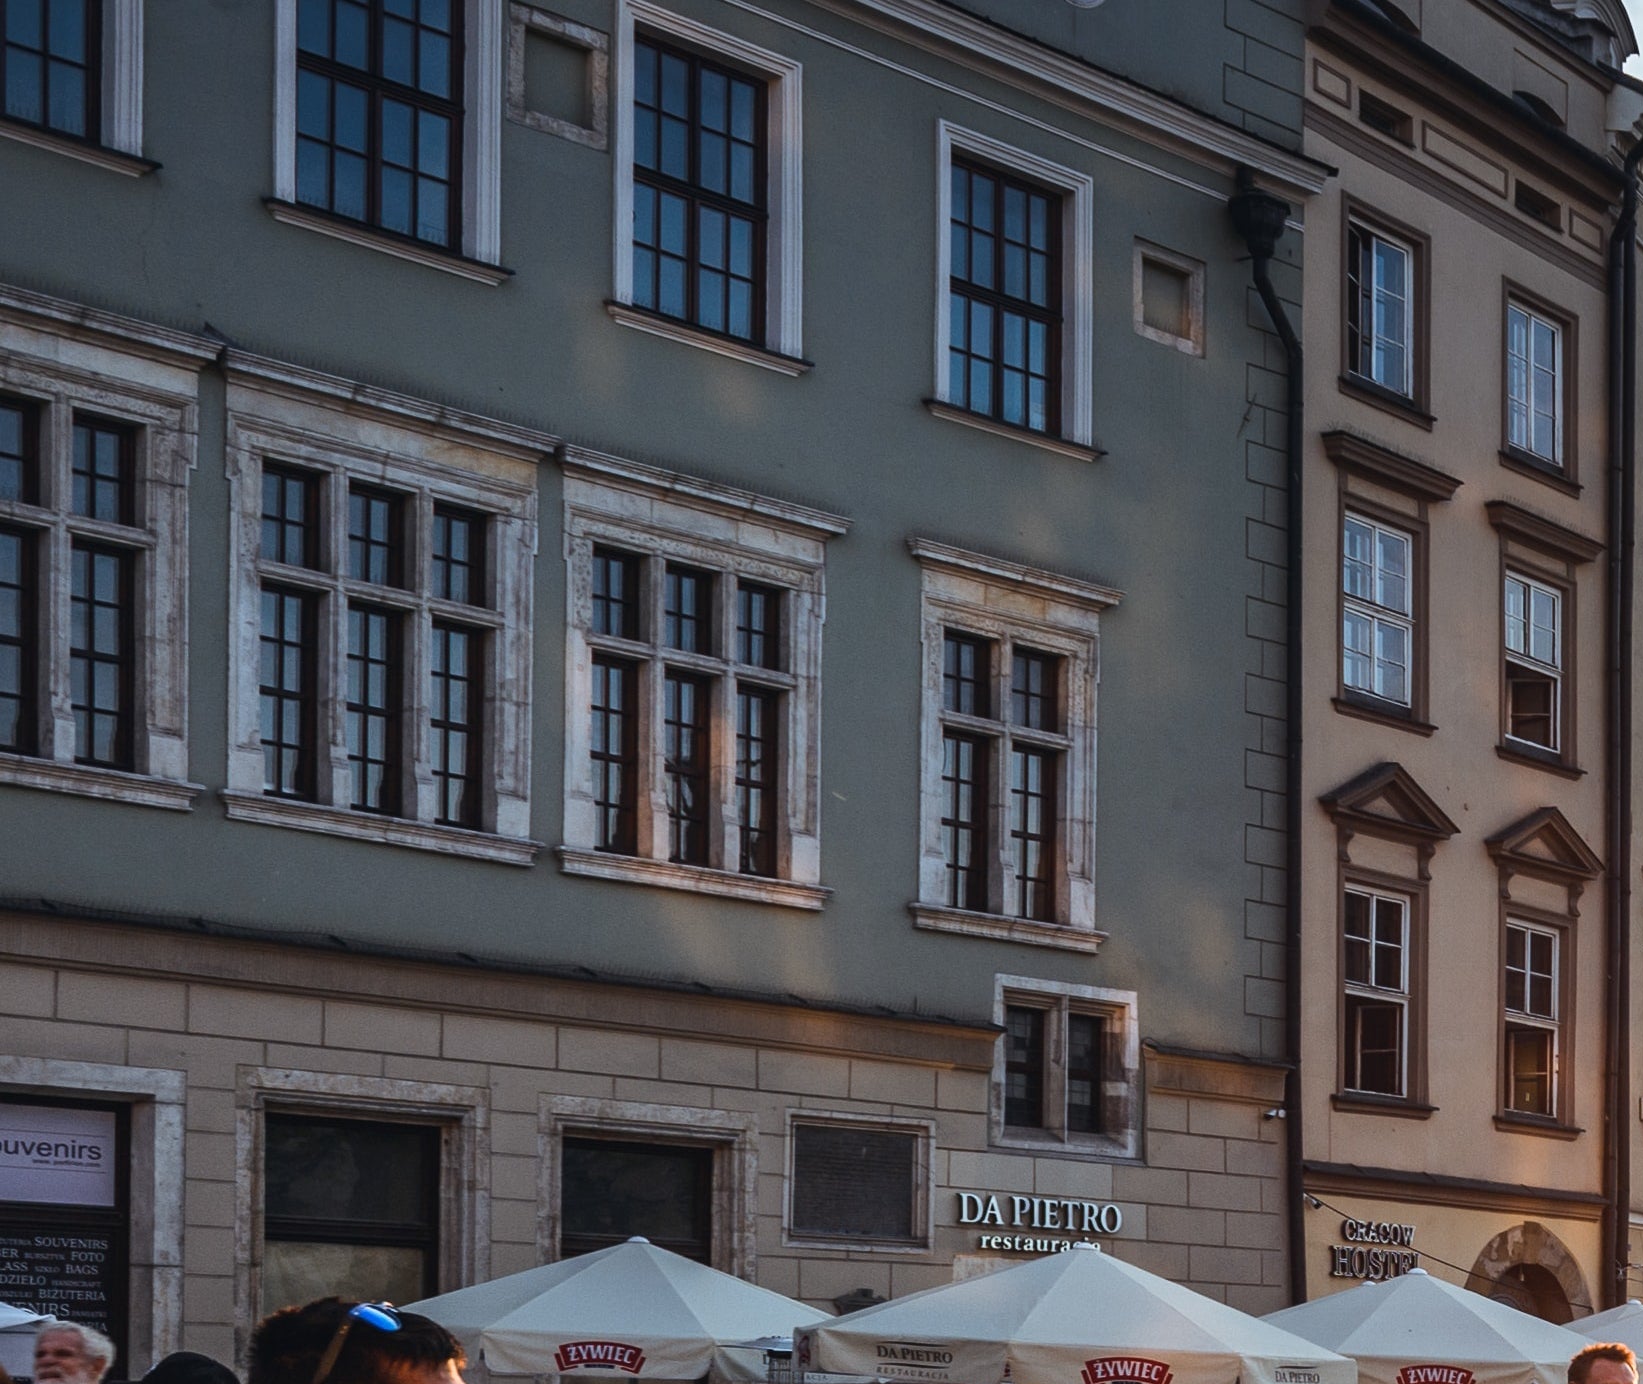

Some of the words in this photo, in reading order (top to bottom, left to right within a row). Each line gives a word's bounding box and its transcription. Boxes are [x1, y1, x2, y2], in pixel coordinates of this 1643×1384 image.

[0, 1139, 102, 1161] uvenirs
[957, 1192, 1005, 1226] DA
[1010, 1195, 1123, 1234] PIETRO
[1343, 1219, 1417, 1247] CRACOW
[34, 1236, 108, 1250] SOUVENIRS
[980, 1235, 1101, 1253] restaura
[0, 1247, 19, 1259] ER
[71, 1250, 105, 1263] FOTO
[65, 1263, 99, 1275] BAGS
[566, 1343, 636, 1364] ŻYWIEC
[876, 1345, 898, 1359] DA
[901, 1347, 953, 1364] PIETRO
[876, 1365, 950, 1380] RESTAURACJA
[1093, 1360, 1163, 1381] ŻYWIEC
[1275, 1370, 1288, 1383] DA
[1288, 1371, 1320, 1384] PIETRO
